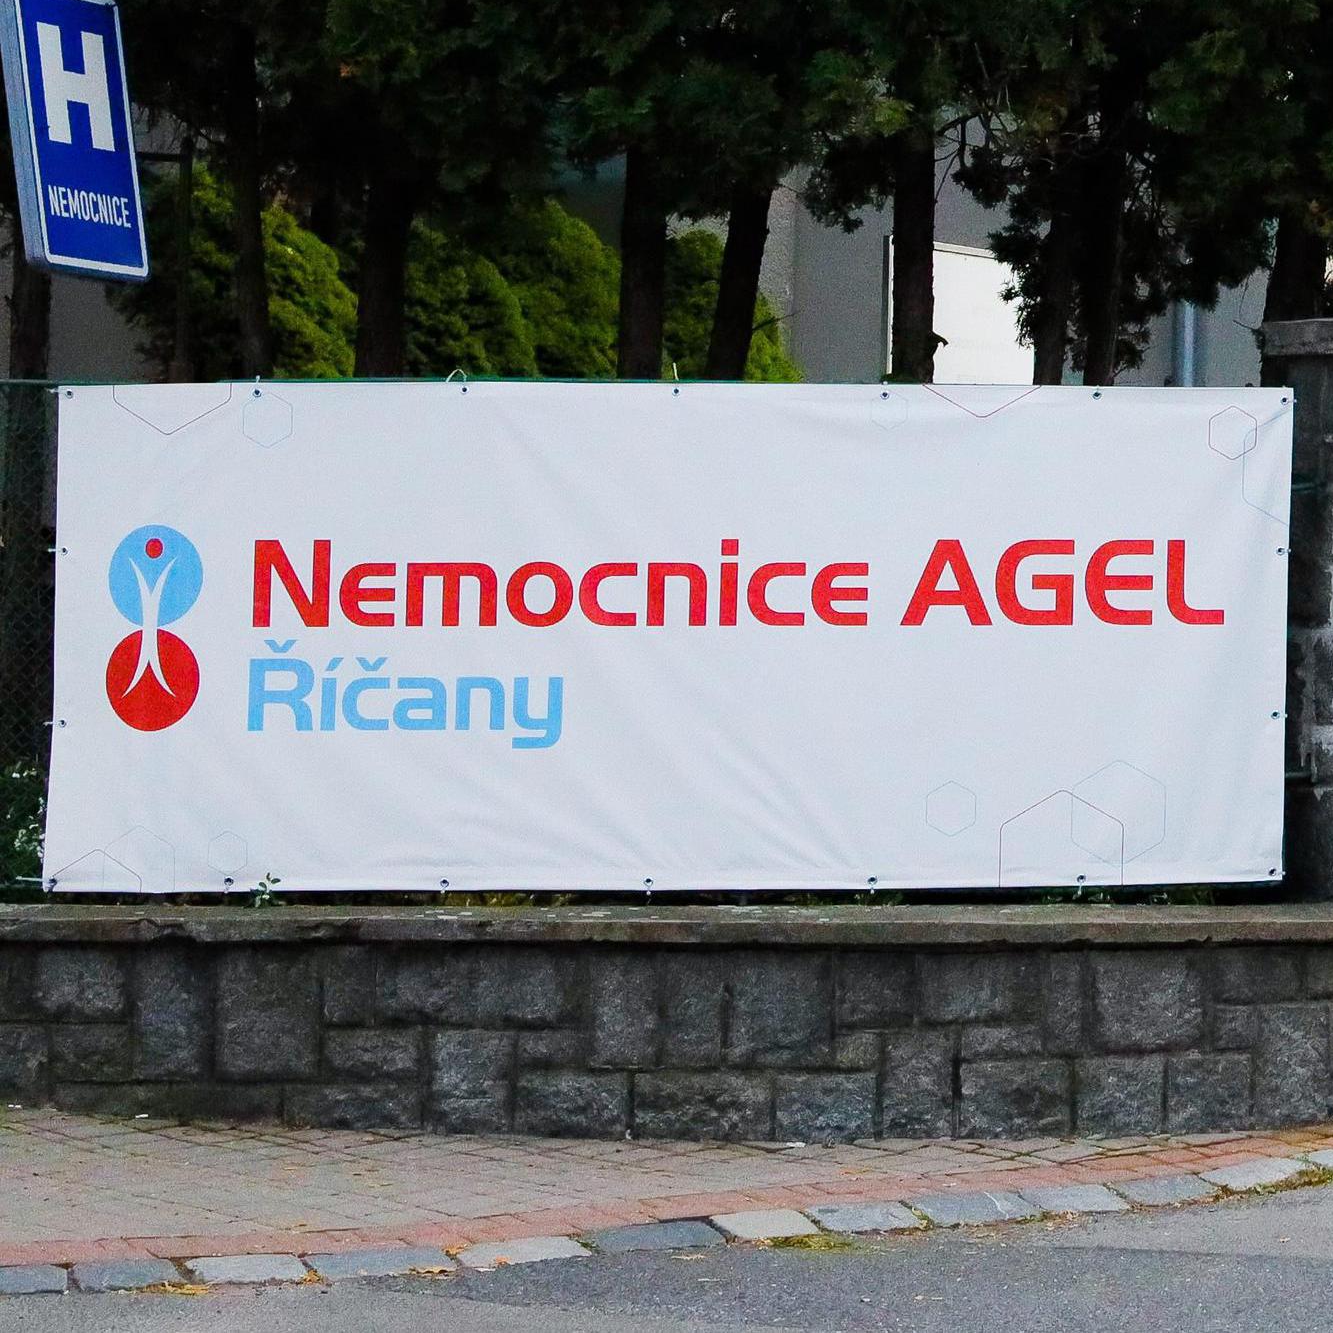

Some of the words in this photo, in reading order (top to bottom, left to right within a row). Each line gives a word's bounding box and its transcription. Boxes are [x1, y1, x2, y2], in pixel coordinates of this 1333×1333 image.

[36, 21, 117, 151] H
[47, 184, 132, 229] NEMOCNICE
[252, 538, 870, 628] Nemocnice
[901, 538, 1226, 628] AGEL
[246, 636, 566, 752] Říčany
